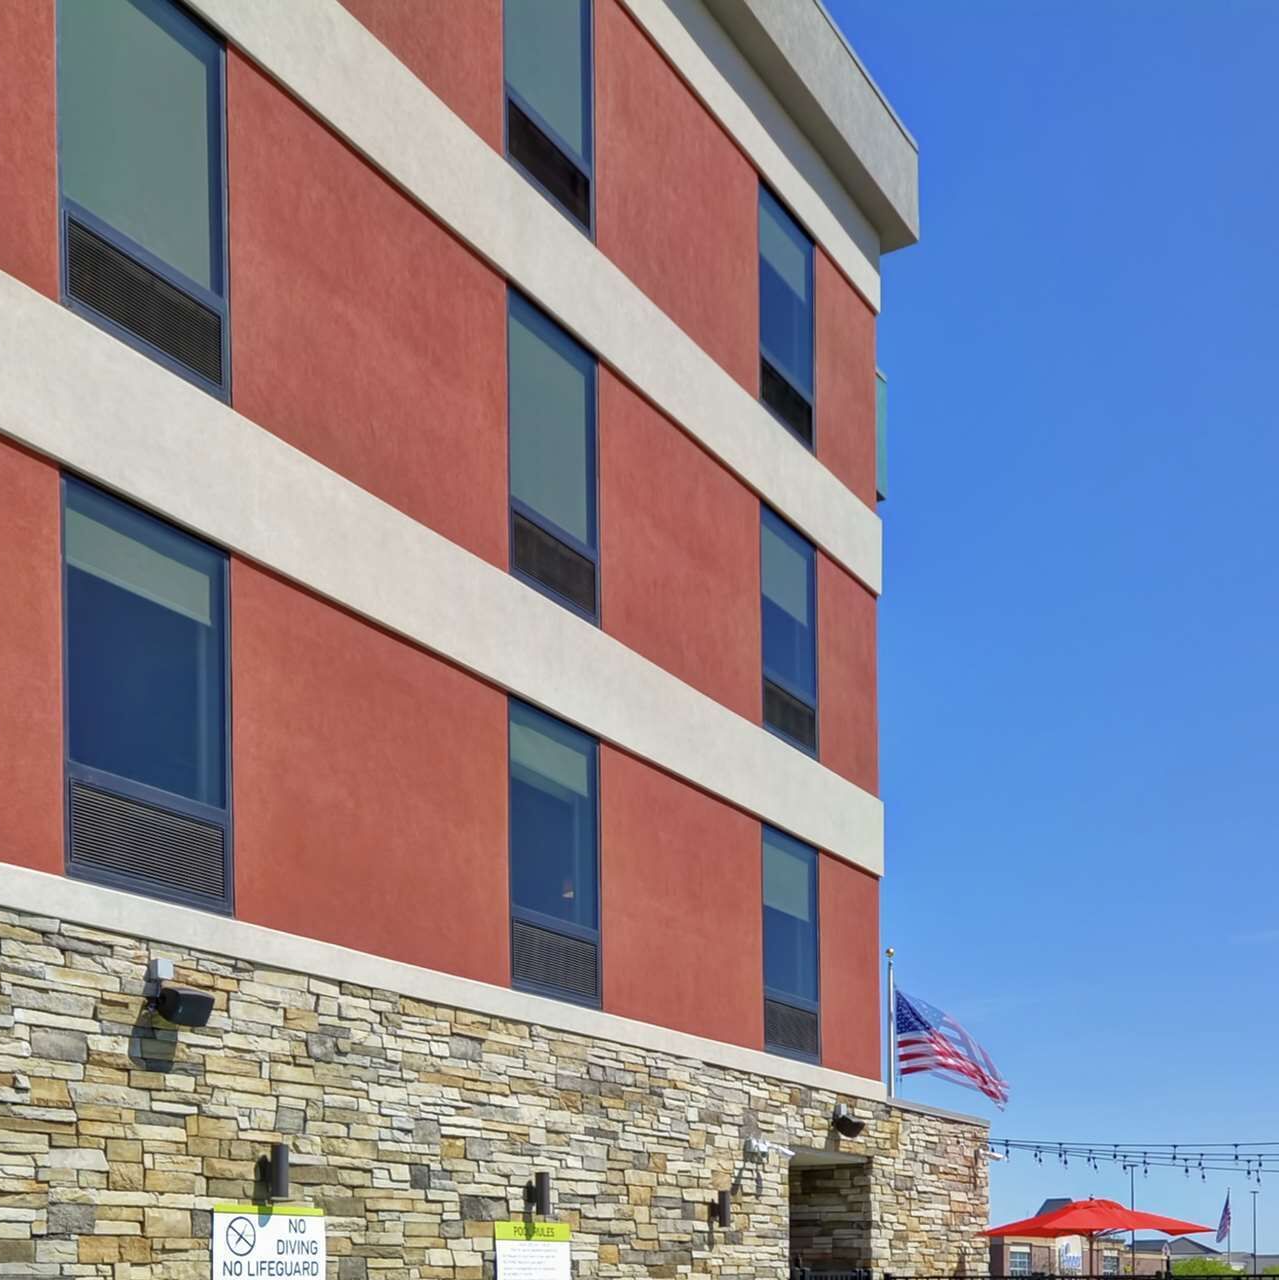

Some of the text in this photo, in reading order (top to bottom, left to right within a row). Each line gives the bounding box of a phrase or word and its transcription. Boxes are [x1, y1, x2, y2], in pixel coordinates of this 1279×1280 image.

[288, 1219, 306, 1234] NO
[513, 1226, 532, 1237] PO
[276, 1239, 318, 1255] DIVING
[222, 1261, 319, 1277] NO LIFEGUARD
